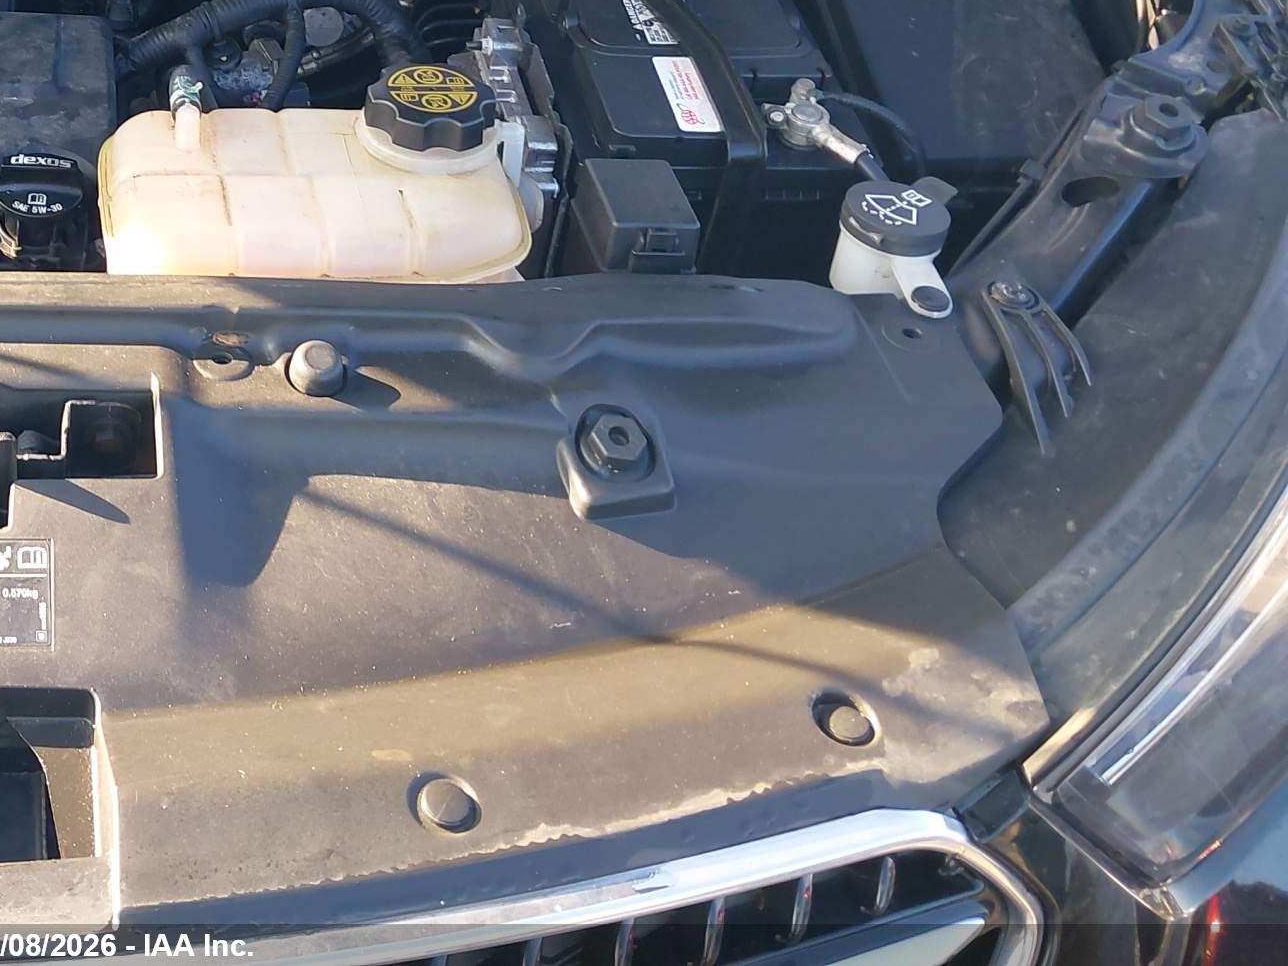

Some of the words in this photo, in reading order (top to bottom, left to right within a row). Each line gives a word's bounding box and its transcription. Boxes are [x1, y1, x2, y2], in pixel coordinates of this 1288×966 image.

[10, 153, 72, 168] dexos
[12, 200, 30, 212] SAE
[31, 203, 64, 214] 5W-30
